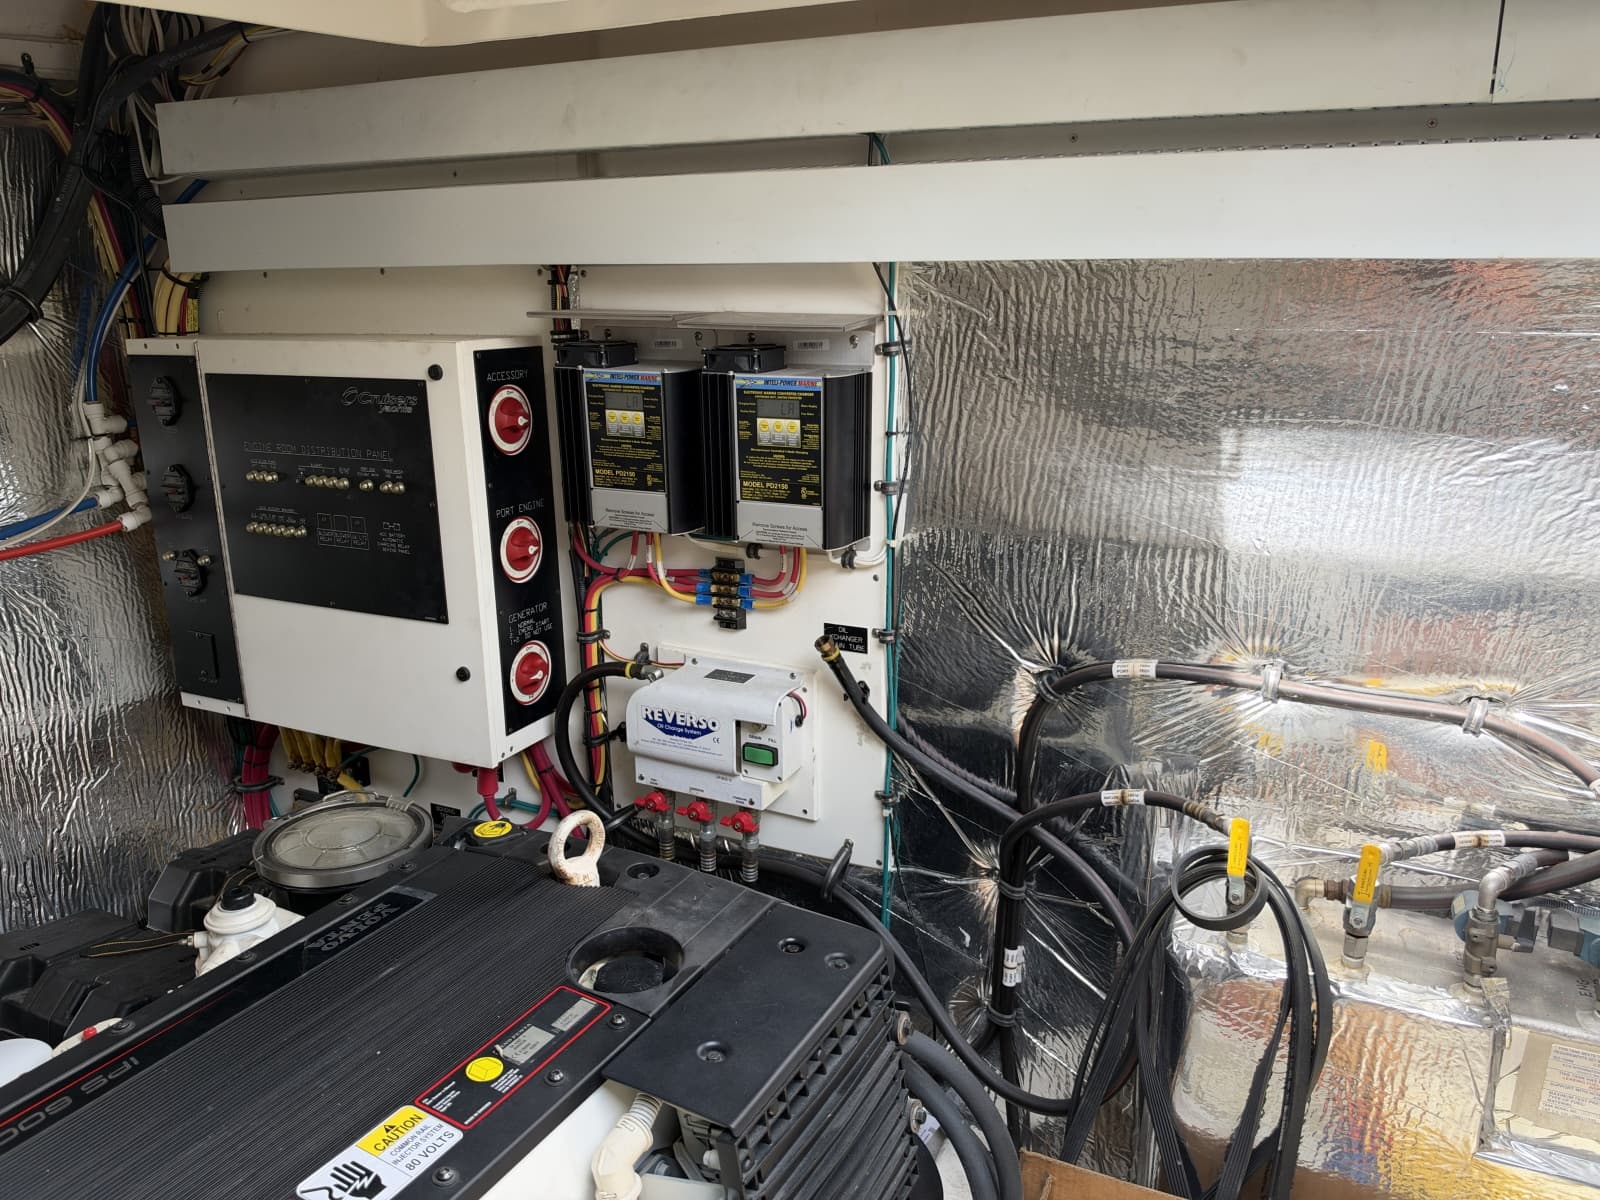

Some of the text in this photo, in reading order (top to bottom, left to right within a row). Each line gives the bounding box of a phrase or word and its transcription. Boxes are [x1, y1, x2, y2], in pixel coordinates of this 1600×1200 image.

[486, 369, 529, 382] ACCESSORY
[300, 444, 362, 458] DISTRIBUTION
[366, 450, 392, 460] PANEL
[595, 469, 615, 477] MODEL
[743, 480, 789, 490] MODEL PD2150
[496, 498, 545, 519] PORT ENGINE
[508, 601, 548, 624] GENERATOR
[838, 626, 849, 634] OIL
[848, 643, 865, 651] TUBE
[640, 704, 720, 732] REVERSO
[665, 724, 684, 733] Change
[684, 728, 702, 736] System
[304, 902, 392, 949] PENTA
[321, 906, 400, 951] VOLVO
[80, 1056, 139, 1094] IPS
[374, 1114, 423, 1152] CAUTION
[390, 1125, 431, 1157] COMMON RAIL
[391, 1123, 445, 1166] INJECTOR SYSTEM
[405, 1130, 455, 1171] 80 VOLTS
